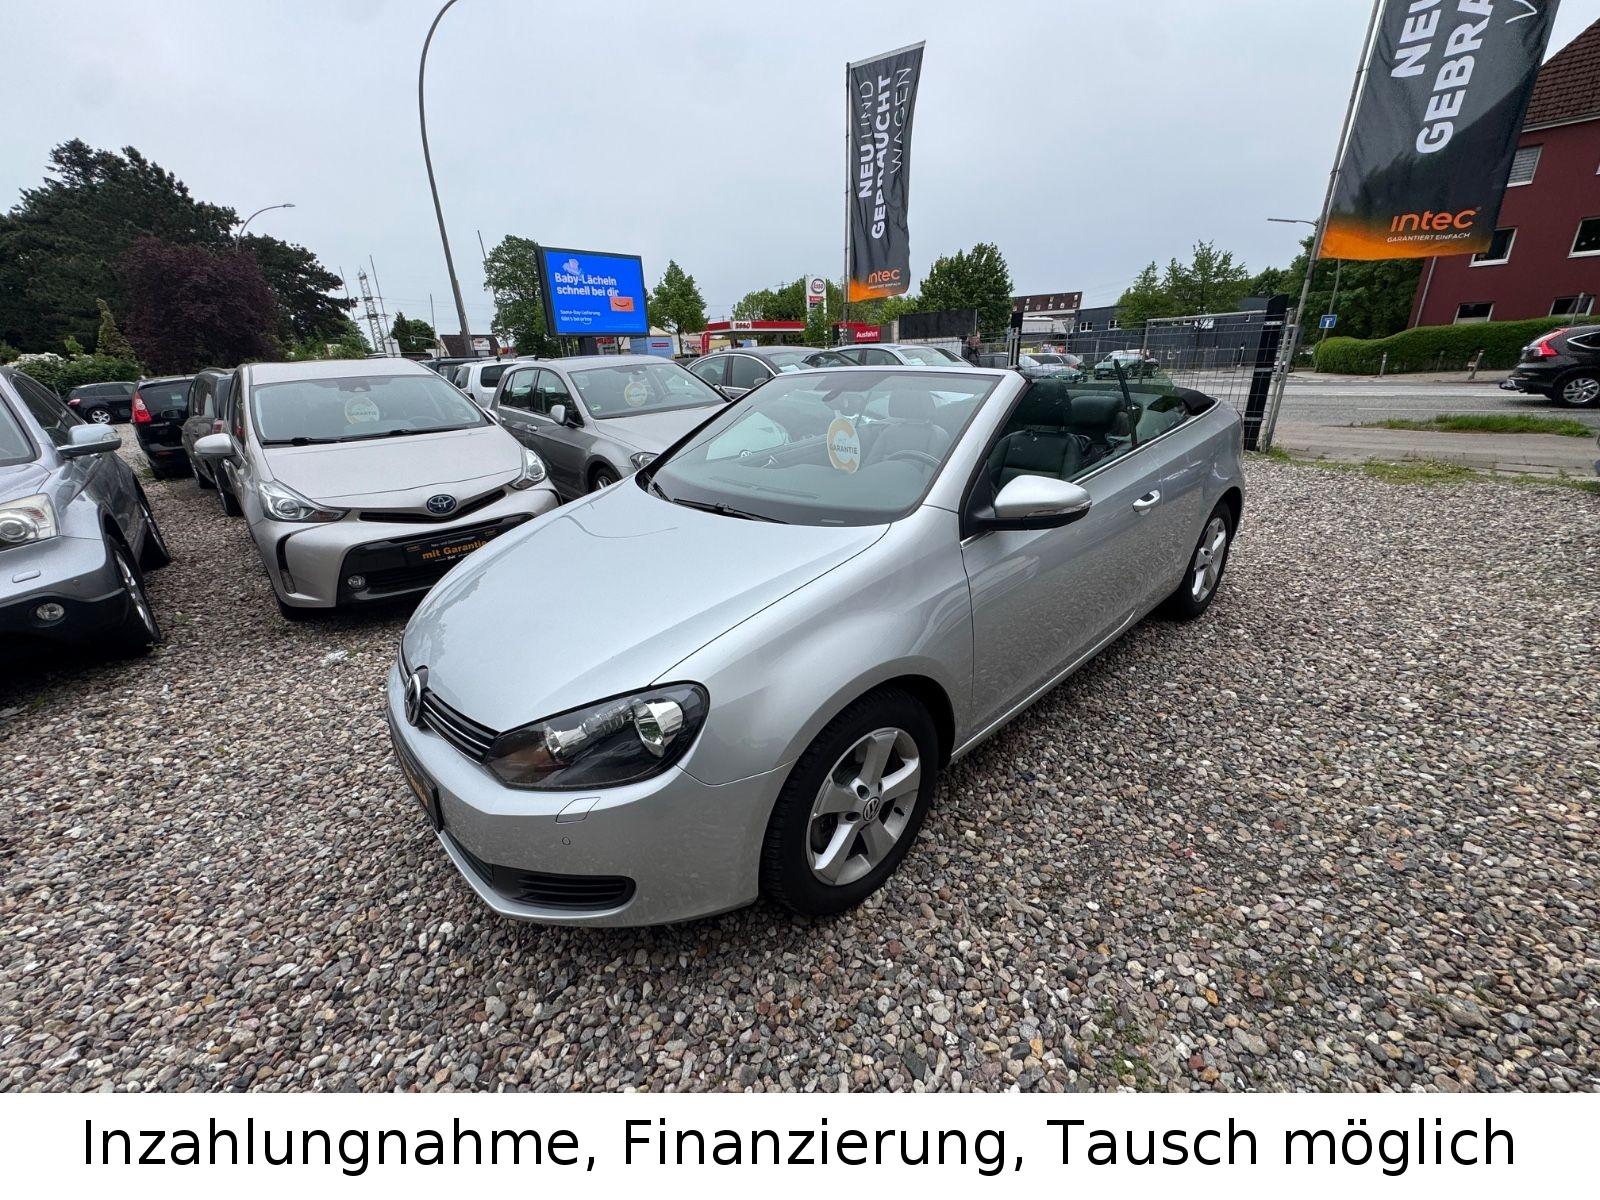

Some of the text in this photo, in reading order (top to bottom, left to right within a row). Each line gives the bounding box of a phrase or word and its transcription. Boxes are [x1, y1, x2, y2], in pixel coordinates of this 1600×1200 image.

[890, 66, 912, 175] WAGEN
[858, 143, 874, 198] NEU
[1390, 208, 1477, 232] intec
[1386, 232, 1471, 243] GARANTIERT EINFACH
[554, 272, 617, 286] Baby-Lächeln
[556, 285, 620, 297] schnell bei dir
[856, 330, 878, 338] Ausfahrt
[422, 549, 441, 560] mit
[443, 540, 488, 556] Garantie
